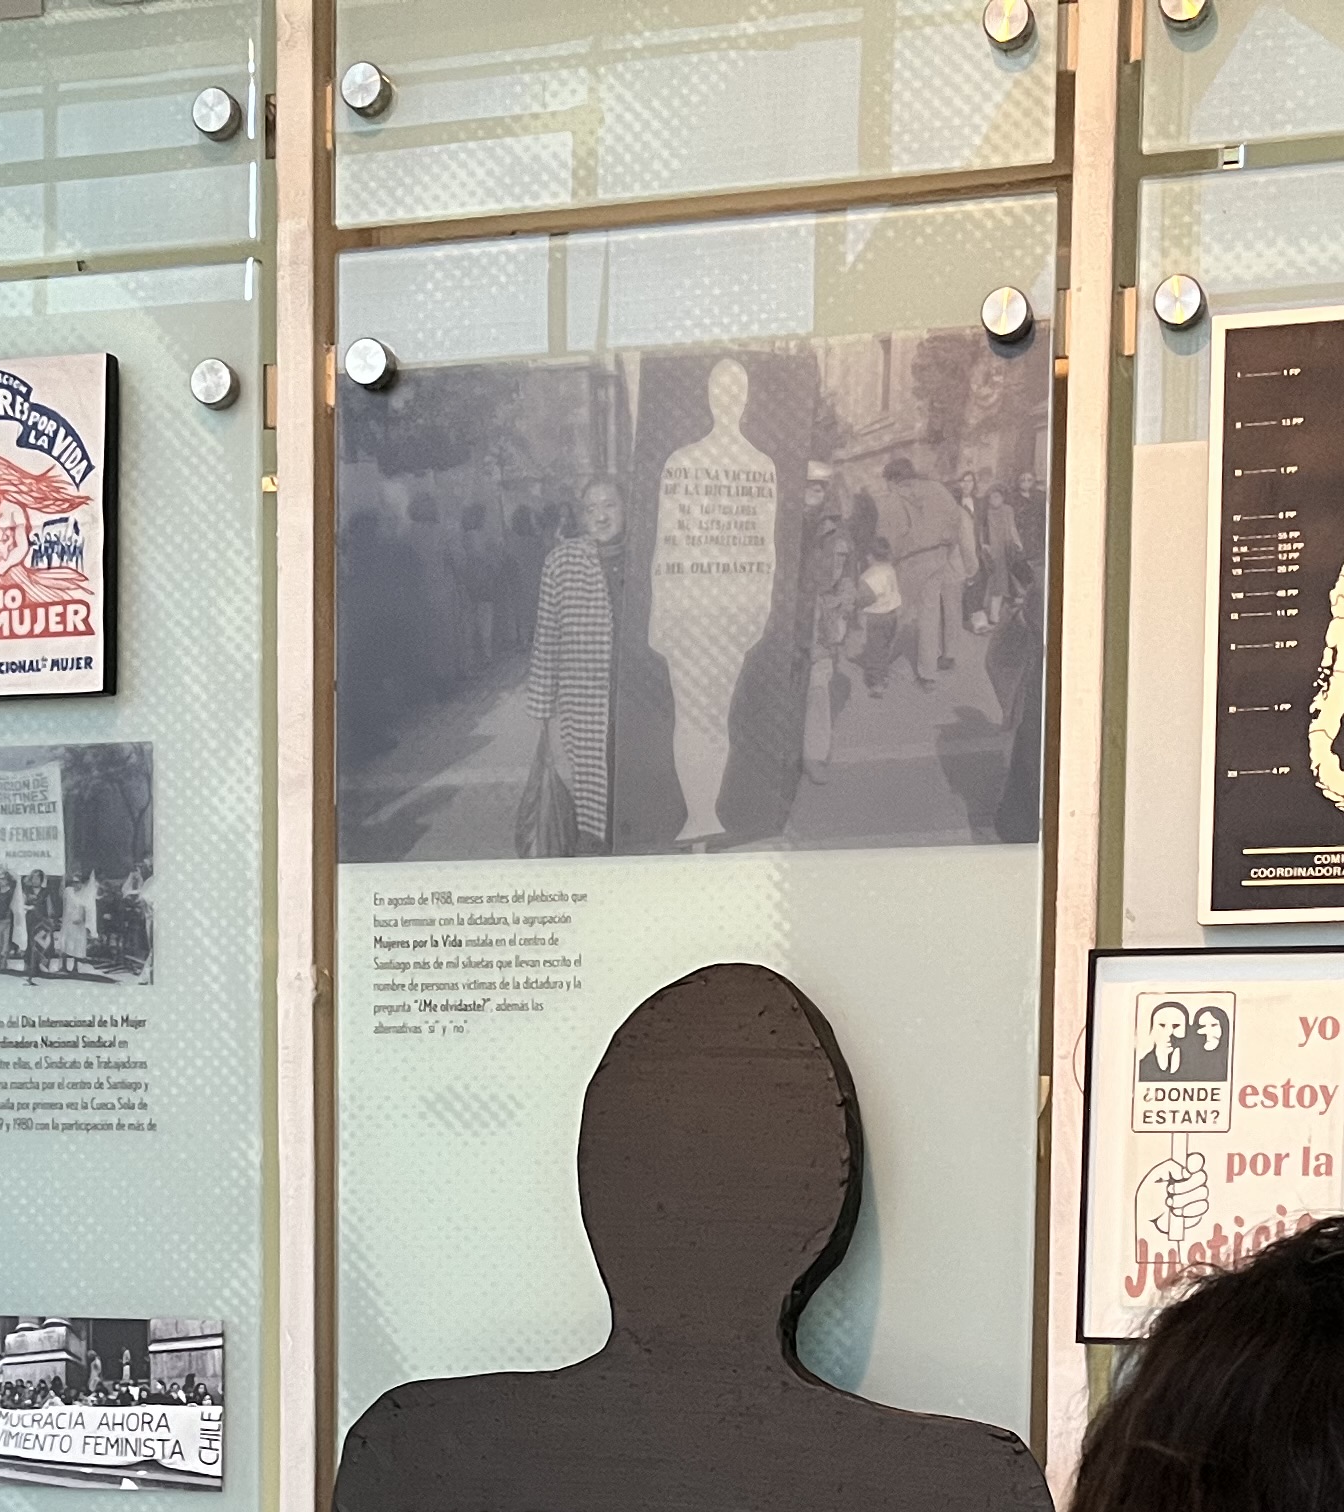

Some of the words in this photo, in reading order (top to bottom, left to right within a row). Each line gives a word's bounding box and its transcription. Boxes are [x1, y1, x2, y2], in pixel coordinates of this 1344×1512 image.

[27, 410, 57, 437] POR
[28, 430, 49, 449] LA
[52, 426, 88, 483] VIDA
[50, 656, 93, 671] MUJER
[418, 892, 429, 905] de
[512, 890, 525, 903] del
[374, 936, 410, 951] Mujeres
[413, 938, 428, 950] por
[430, 934, 438, 947] la
[441, 934, 463, 947] Vida
[38, 1014, 95, 1028] Internacional
[97, 1014, 108, 1028] de
[110, 1014, 118, 1028] la
[1298, 1015, 1341, 1047] yo
[1143, 1087, 1221, 1103] ¿DONDE
[1238, 1078, 1340, 1115] estoy
[1142, 1110, 1220, 1125] ESTAN?
[1225, 1152, 1290, 1183] por
[1301, 1146, 1334, 1177] la
[97, 1412, 171, 1433] AHORA
[199, 1410, 223, 1465] CHILE
[82, 1435, 185, 1462] FEMINISTA
